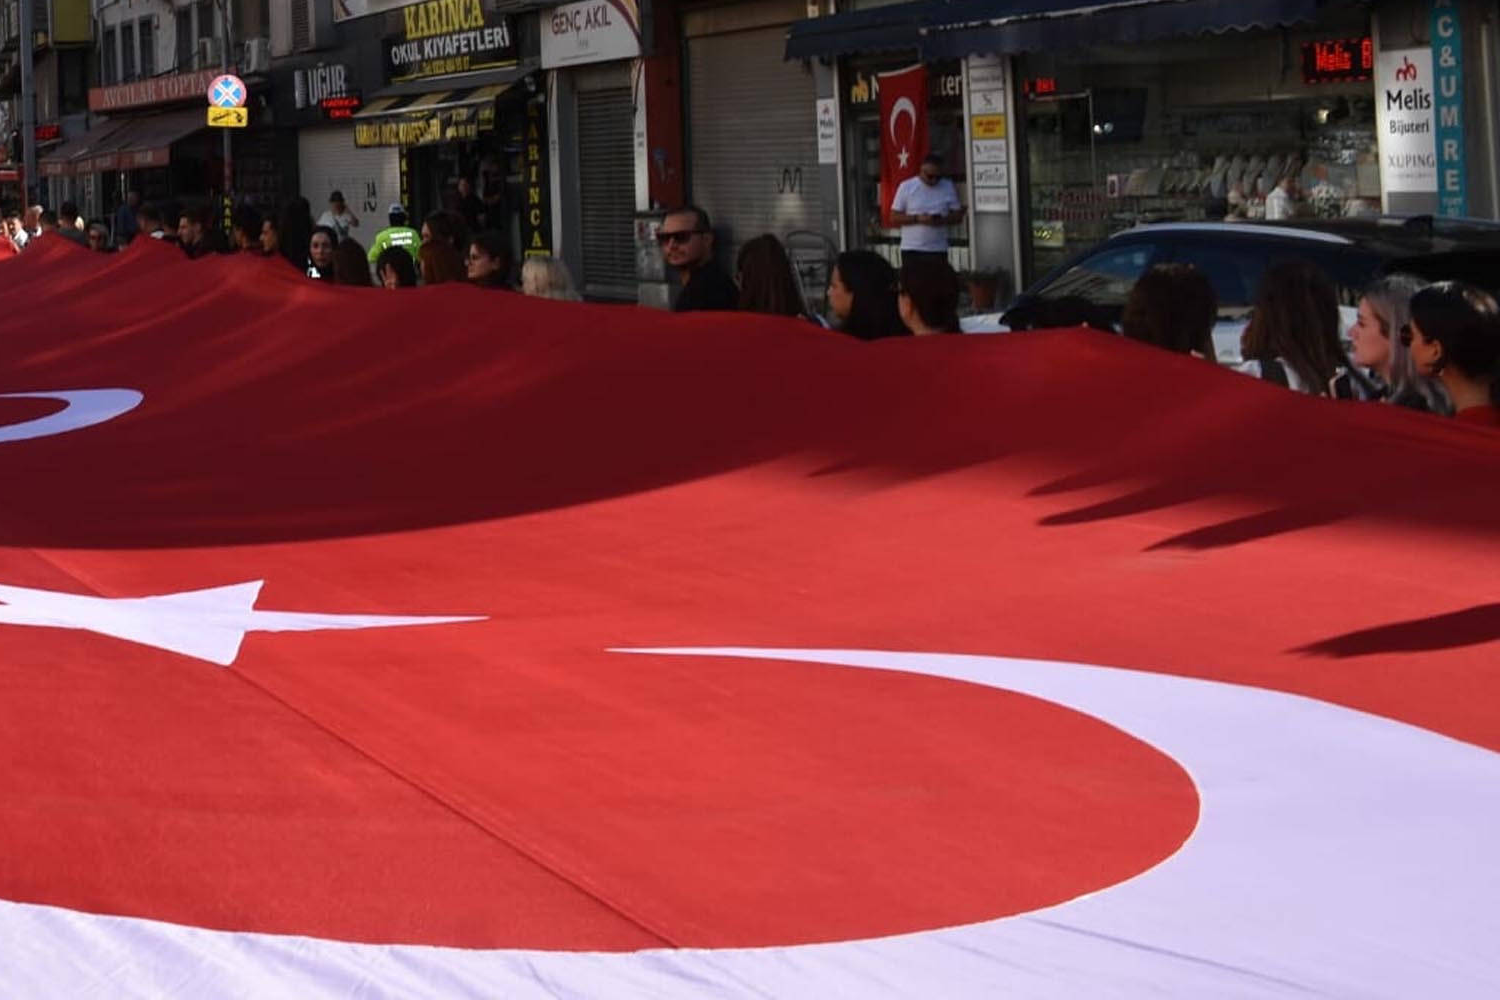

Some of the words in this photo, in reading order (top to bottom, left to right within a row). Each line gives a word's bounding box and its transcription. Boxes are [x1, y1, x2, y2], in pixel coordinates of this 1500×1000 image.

[551, 9, 582, 36] GENÇ
[391, 42, 421, 65] OKUL
[423, 20, 510, 59] KIYAFETLERİ
[1316, 42, 1352, 72] Melis
[308, 61, 347, 106] UĞUR
[1386, 87, 1432, 112] Melis
[1389, 118, 1430, 135] Bijuteri
[1387, 153, 1436, 169] XUPING
